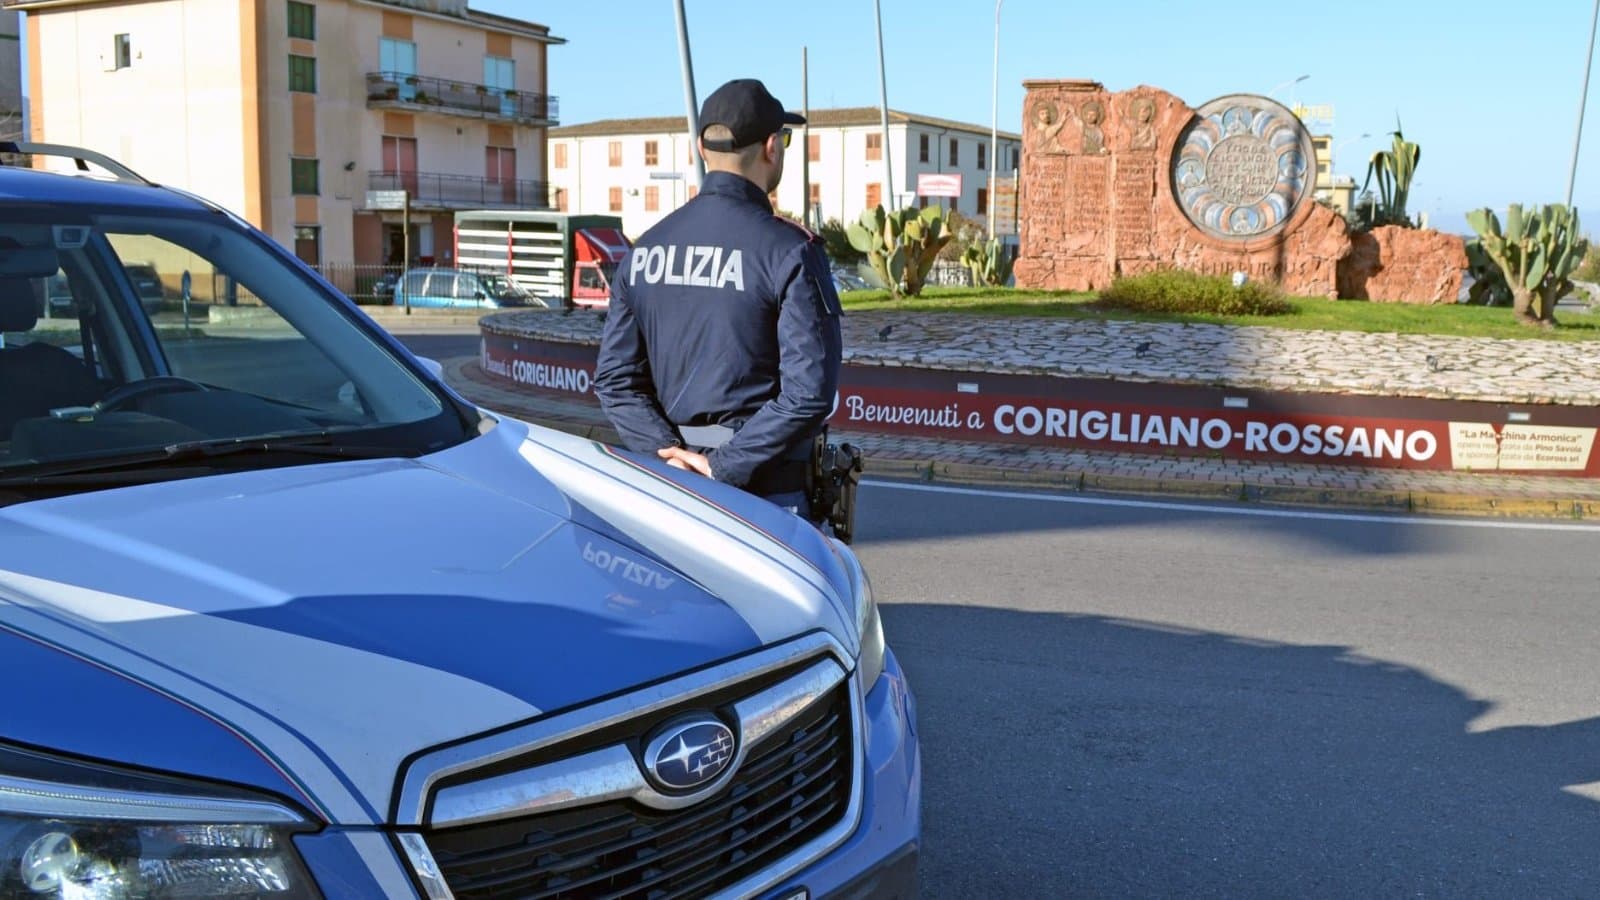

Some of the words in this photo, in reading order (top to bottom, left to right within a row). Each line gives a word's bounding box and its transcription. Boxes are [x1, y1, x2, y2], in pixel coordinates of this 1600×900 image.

[630, 244, 745, 291] POLIZIA
[512, 359, 597, 394] CORIGLIANO-
[846, 395, 962, 428] Benvenuti
[967, 411, 985, 429] a
[993, 404, 1438, 461] CORIGLIANO-ROSSANO
